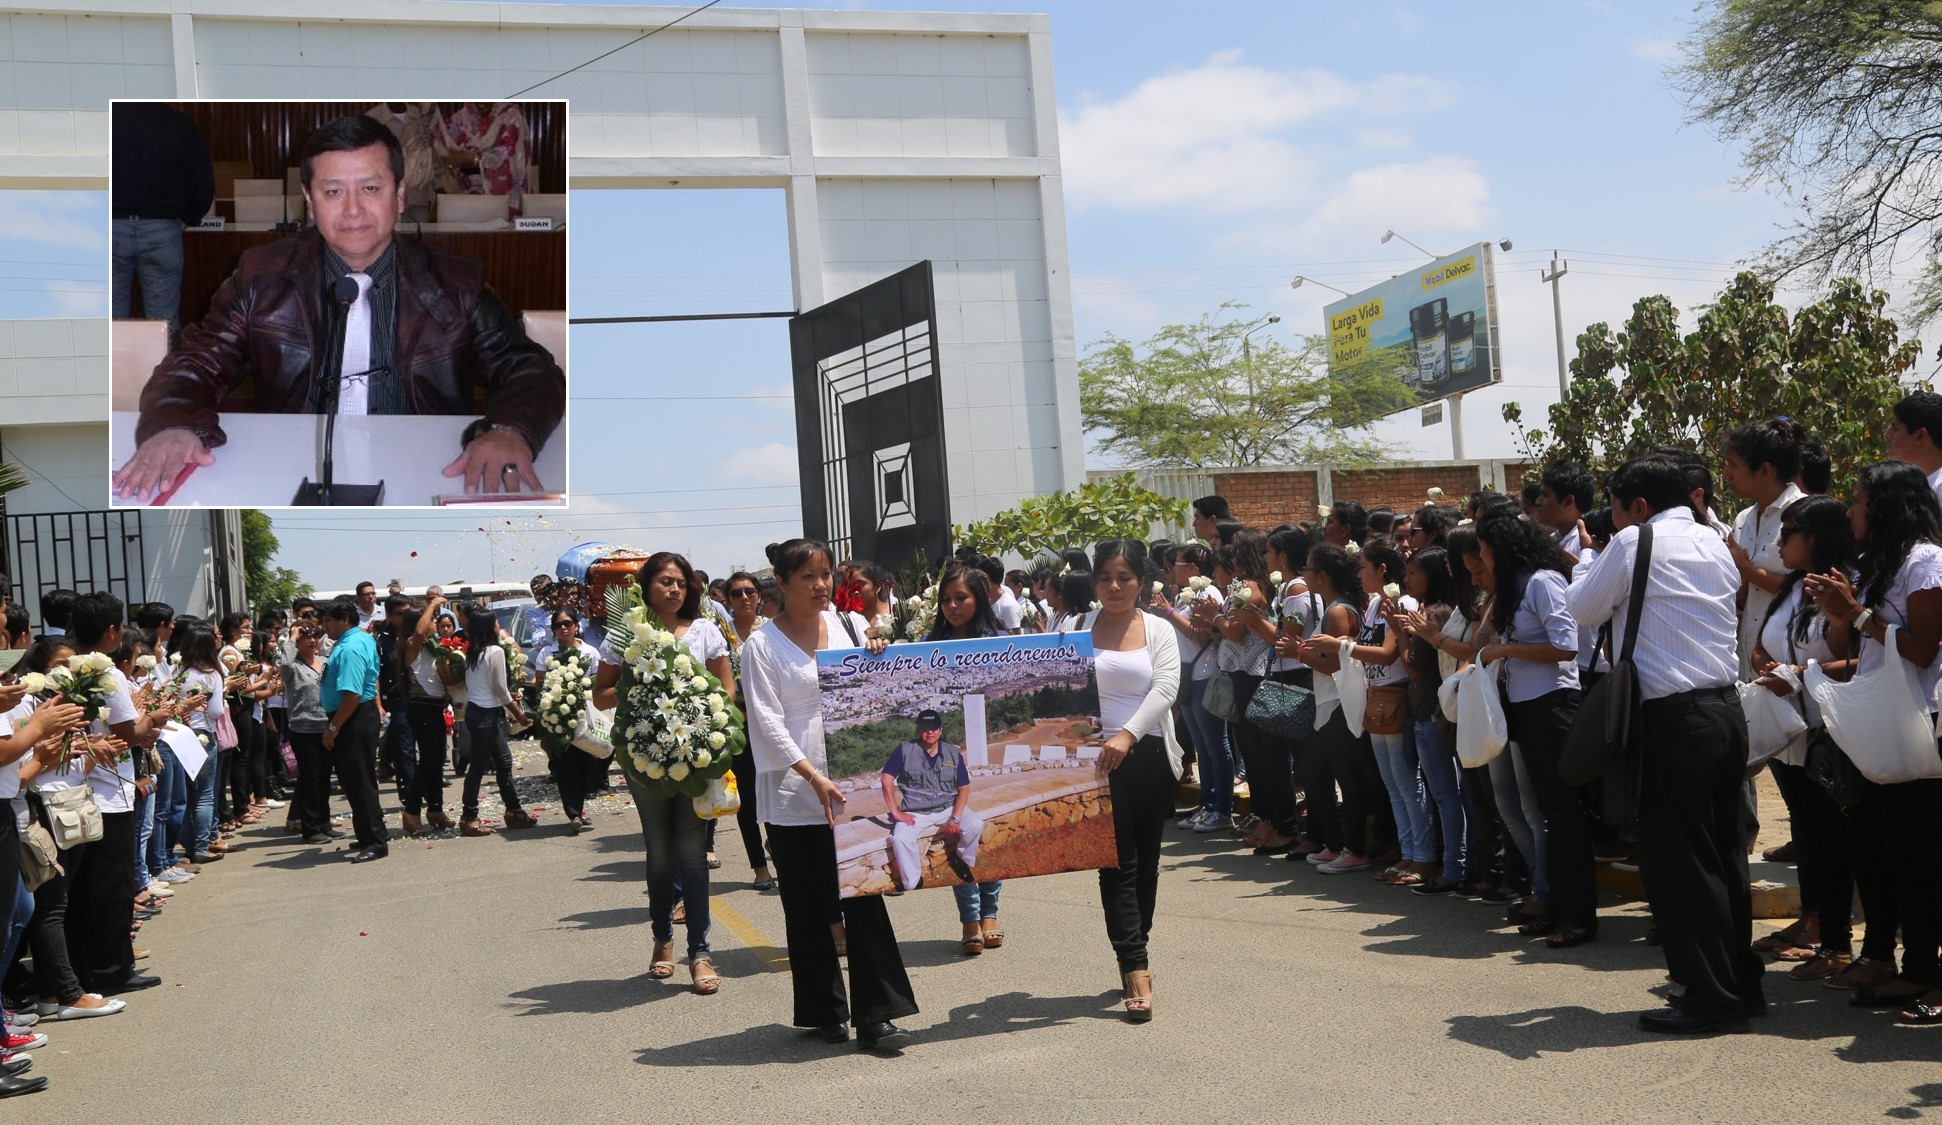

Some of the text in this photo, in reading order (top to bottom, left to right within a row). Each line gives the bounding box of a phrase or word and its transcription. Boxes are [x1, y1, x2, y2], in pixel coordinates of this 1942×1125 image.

[1425, 262, 1471, 286] Mobil Delvac
[1332, 302, 1380, 331] Larga Vida
[1355, 326, 1367, 339] Tu
[1335, 346, 1363, 362] Motor
[839, 643, 1075, 677] Siempre lo recordaremos
